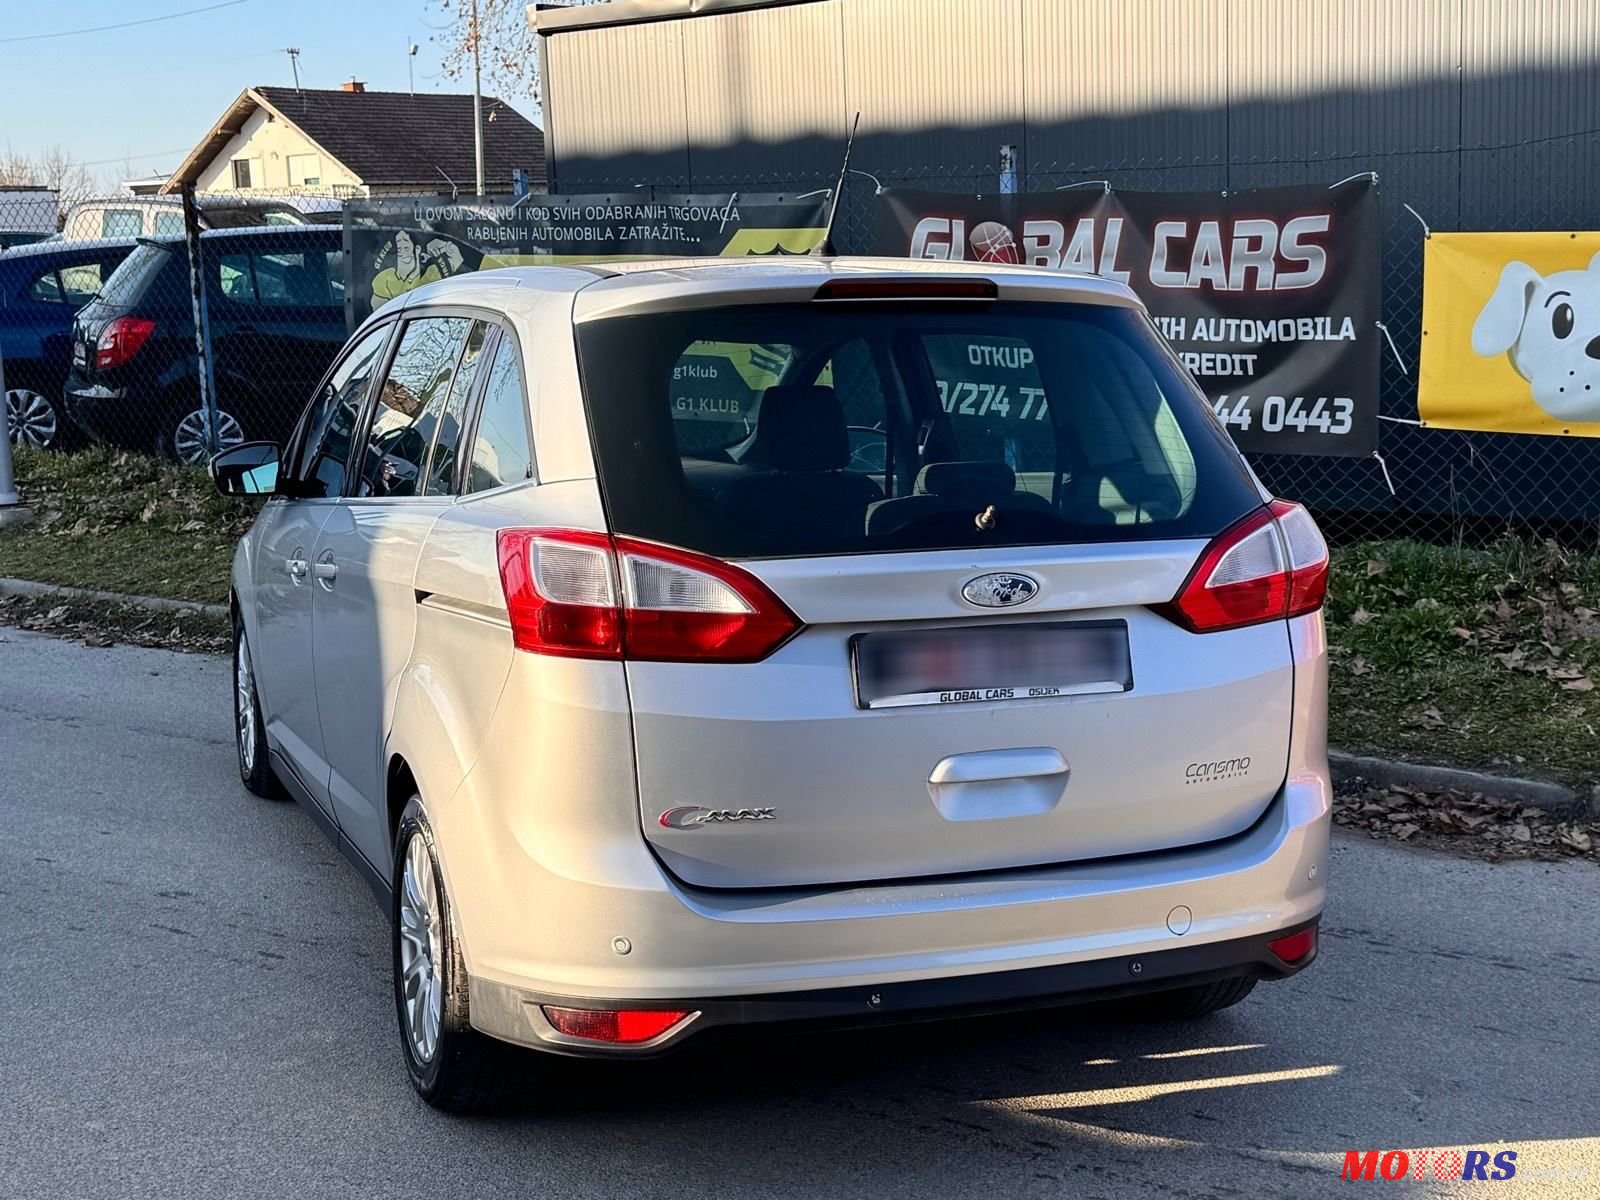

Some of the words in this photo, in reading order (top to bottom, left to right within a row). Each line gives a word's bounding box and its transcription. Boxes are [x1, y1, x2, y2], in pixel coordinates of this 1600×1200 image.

[414, 206, 422, 221] U
[425, 206, 464, 221] OVOM
[466, 206, 514, 221] SALONU
[518, 207, 522, 221] I
[525, 206, 550, 221] KOD
[553, 206, 581, 221] SVIH
[585, 205, 667, 221] ODABRANIH
[668, 206, 740, 221] TRGOVACA
[467, 227, 528, 243] RABLJENIH
[532, 226, 614, 241] AUTOMOBILA
[618, 222, 700, 243] ZATRAŽITE...
[1148, 214, 1330, 291] CARS
[1191, 316, 1357, 343] AUTOMOBILA
[967, 344, 1034, 369] OTKUP
[1178, 352, 1258, 376] REDIT
[673, 364, 718, 380] g1klub
[676, 396, 693, 411] G1
[699, 398, 740, 414] KLUB
[1261, 395, 1354, 435] 0443
[940, 690, 983, 703] GLOBAL
[985, 688, 1015, 700] CARS
